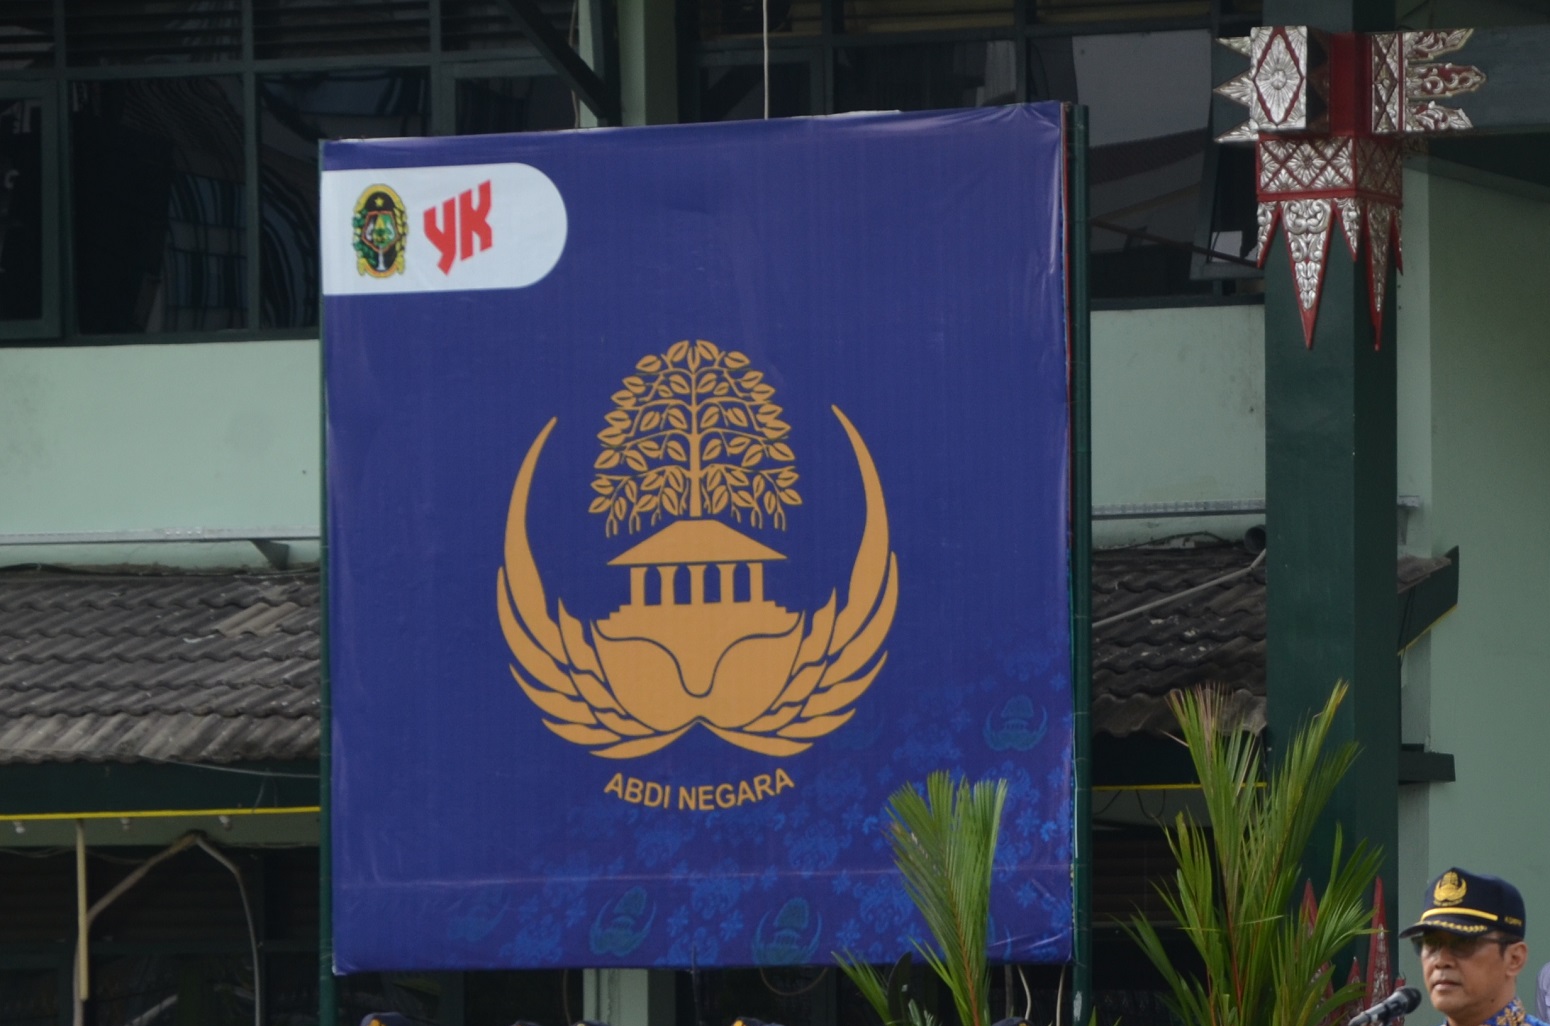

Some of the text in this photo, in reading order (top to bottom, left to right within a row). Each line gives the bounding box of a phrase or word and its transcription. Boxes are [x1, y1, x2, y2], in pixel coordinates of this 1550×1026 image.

[423, 179, 493, 276] YK
[604, 768, 795, 811] ABDI NEGARA
